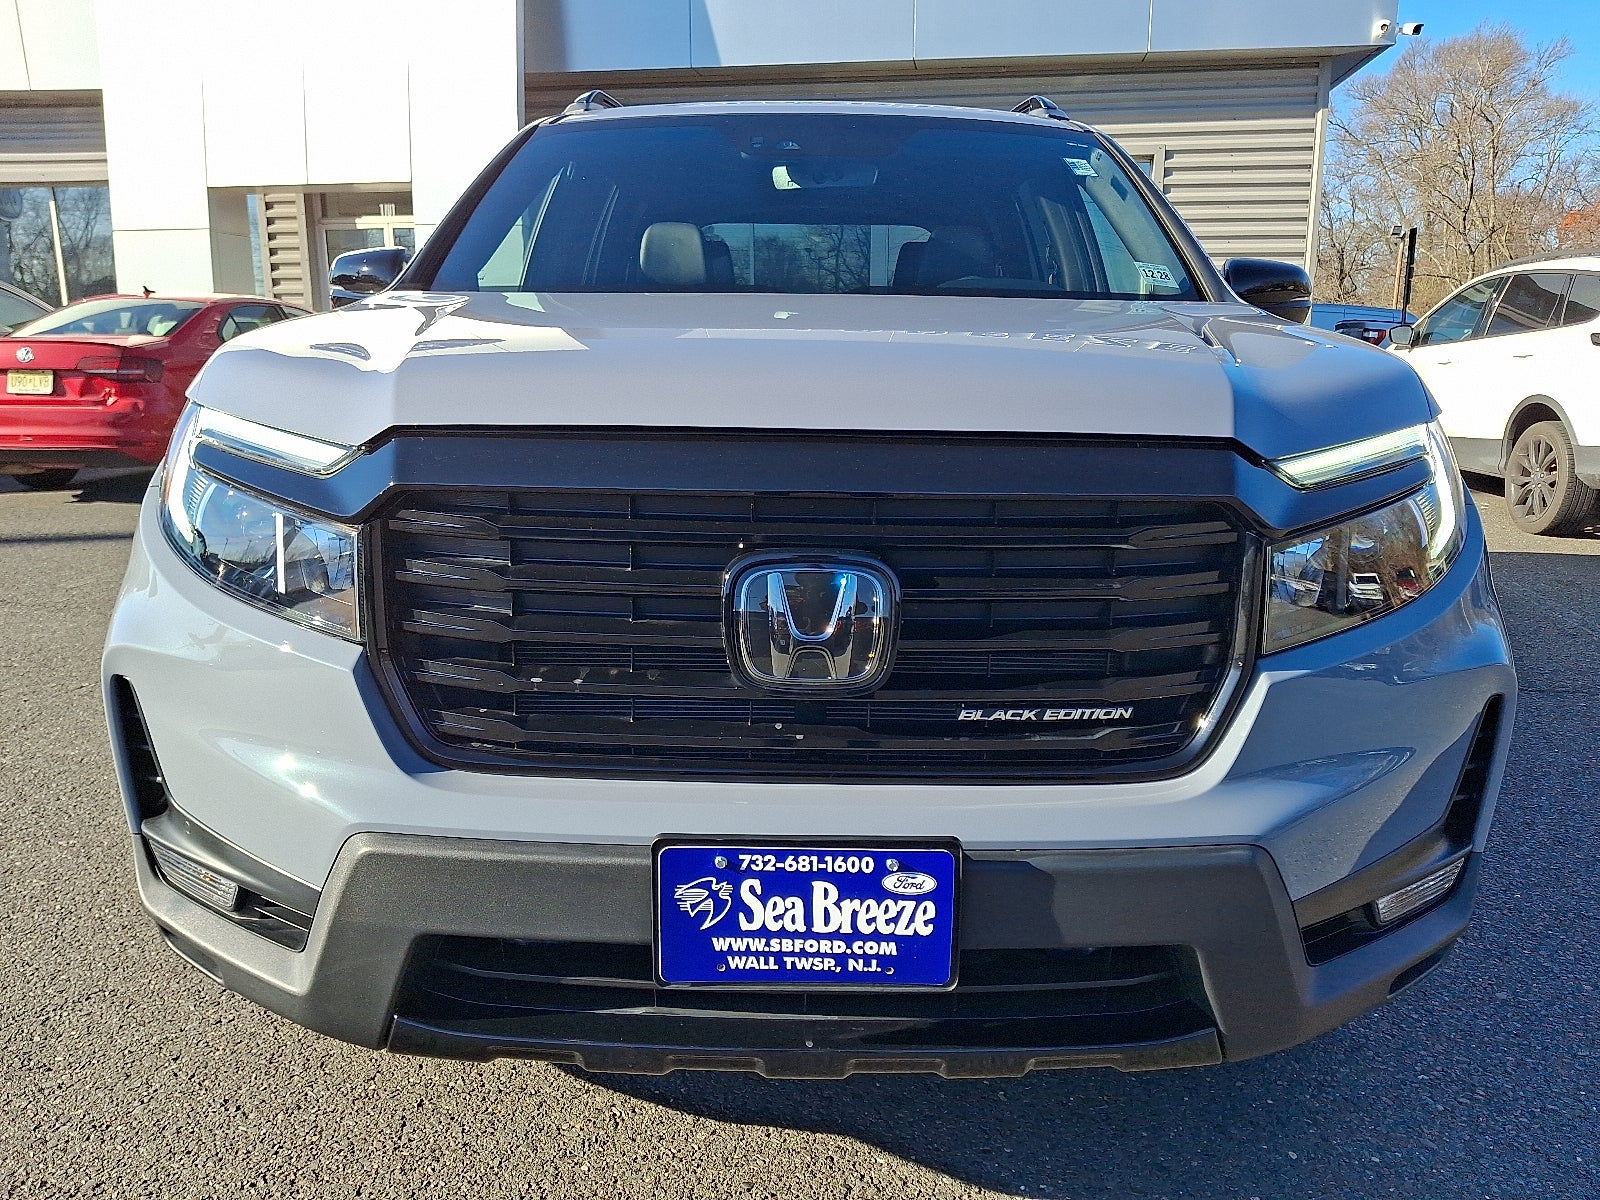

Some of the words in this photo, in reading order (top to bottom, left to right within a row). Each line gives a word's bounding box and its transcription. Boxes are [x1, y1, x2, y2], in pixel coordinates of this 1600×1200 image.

[958, 708, 1040, 721] BLACK
[1043, 706, 1134, 721] EDITION
[738, 854, 875, 874] 732-681-1600
[892, 874, 925, 891] Ford
[738, 878, 806, 933] Sea
[811, 880, 936, 936] Breeze
[711, 937, 898, 955] WWW.SBFORD.COM
[727, 956, 779, 970] WALL
[848, 959, 882, 972] N.J.
